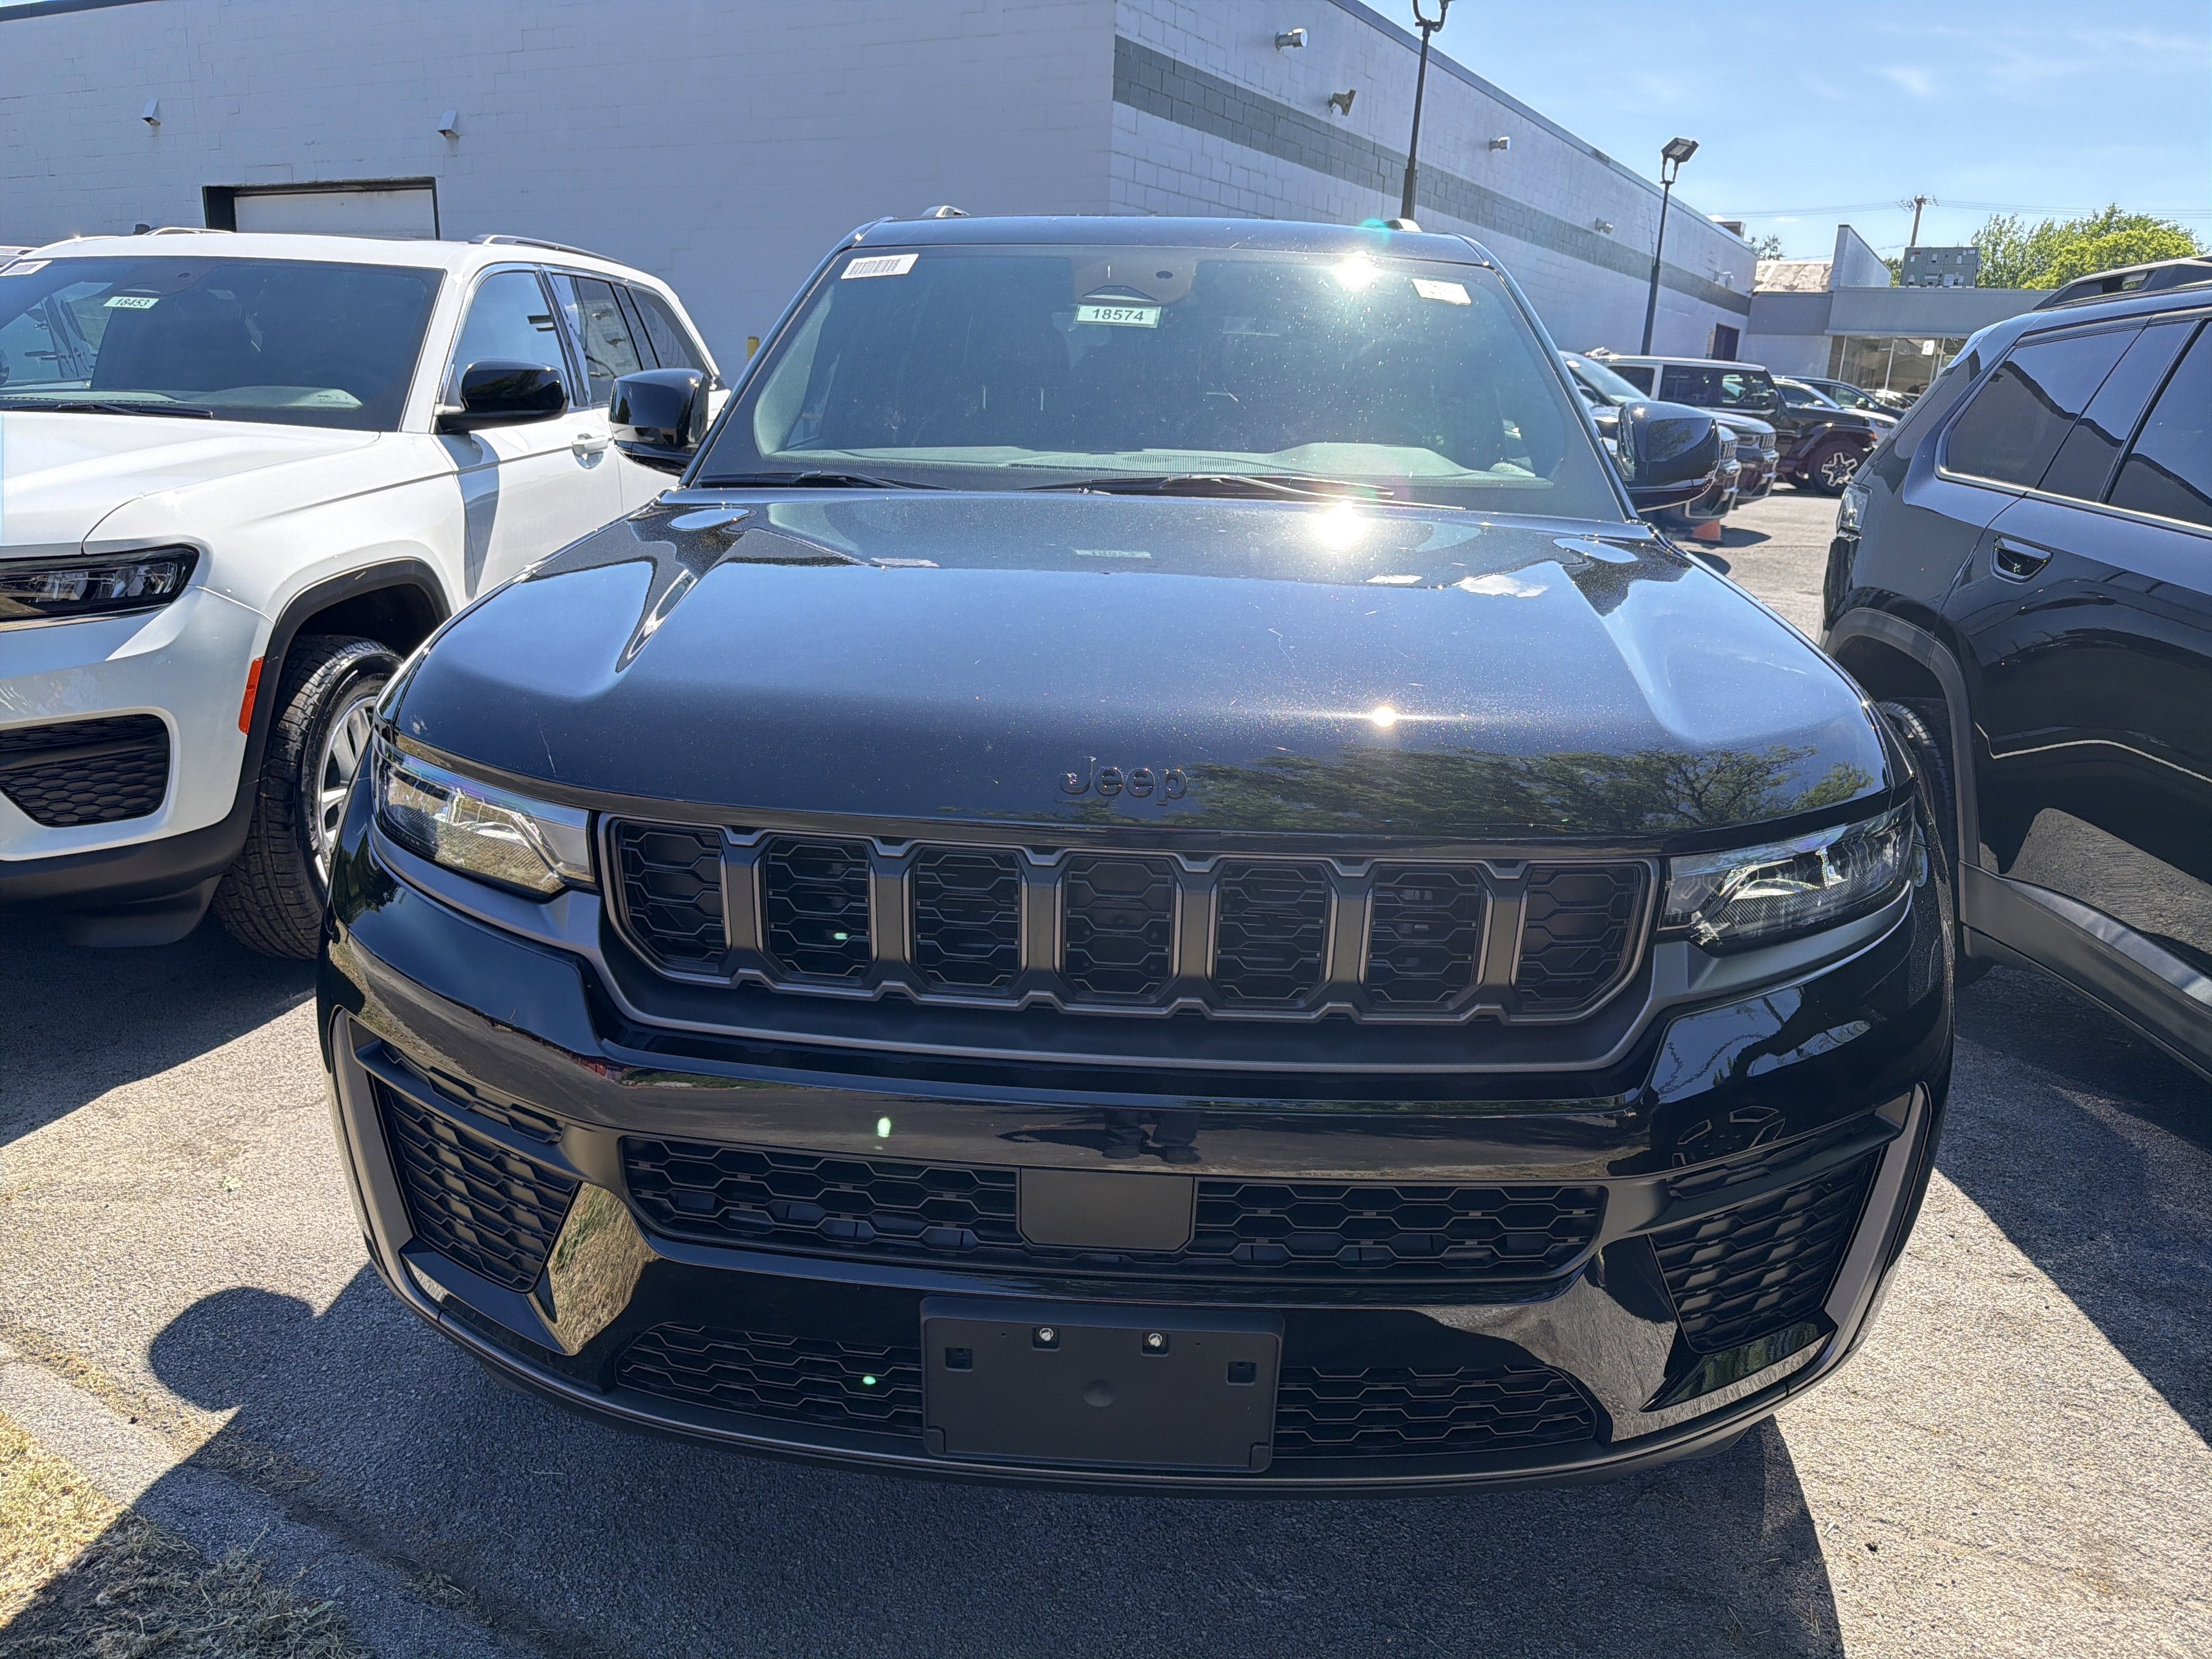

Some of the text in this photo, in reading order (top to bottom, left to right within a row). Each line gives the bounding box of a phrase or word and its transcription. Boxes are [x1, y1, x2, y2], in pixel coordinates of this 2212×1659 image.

[114, 298, 150, 307] 18453
[1092, 308, 1144, 321] 18574
[1059, 755, 1188, 806] Jeep
